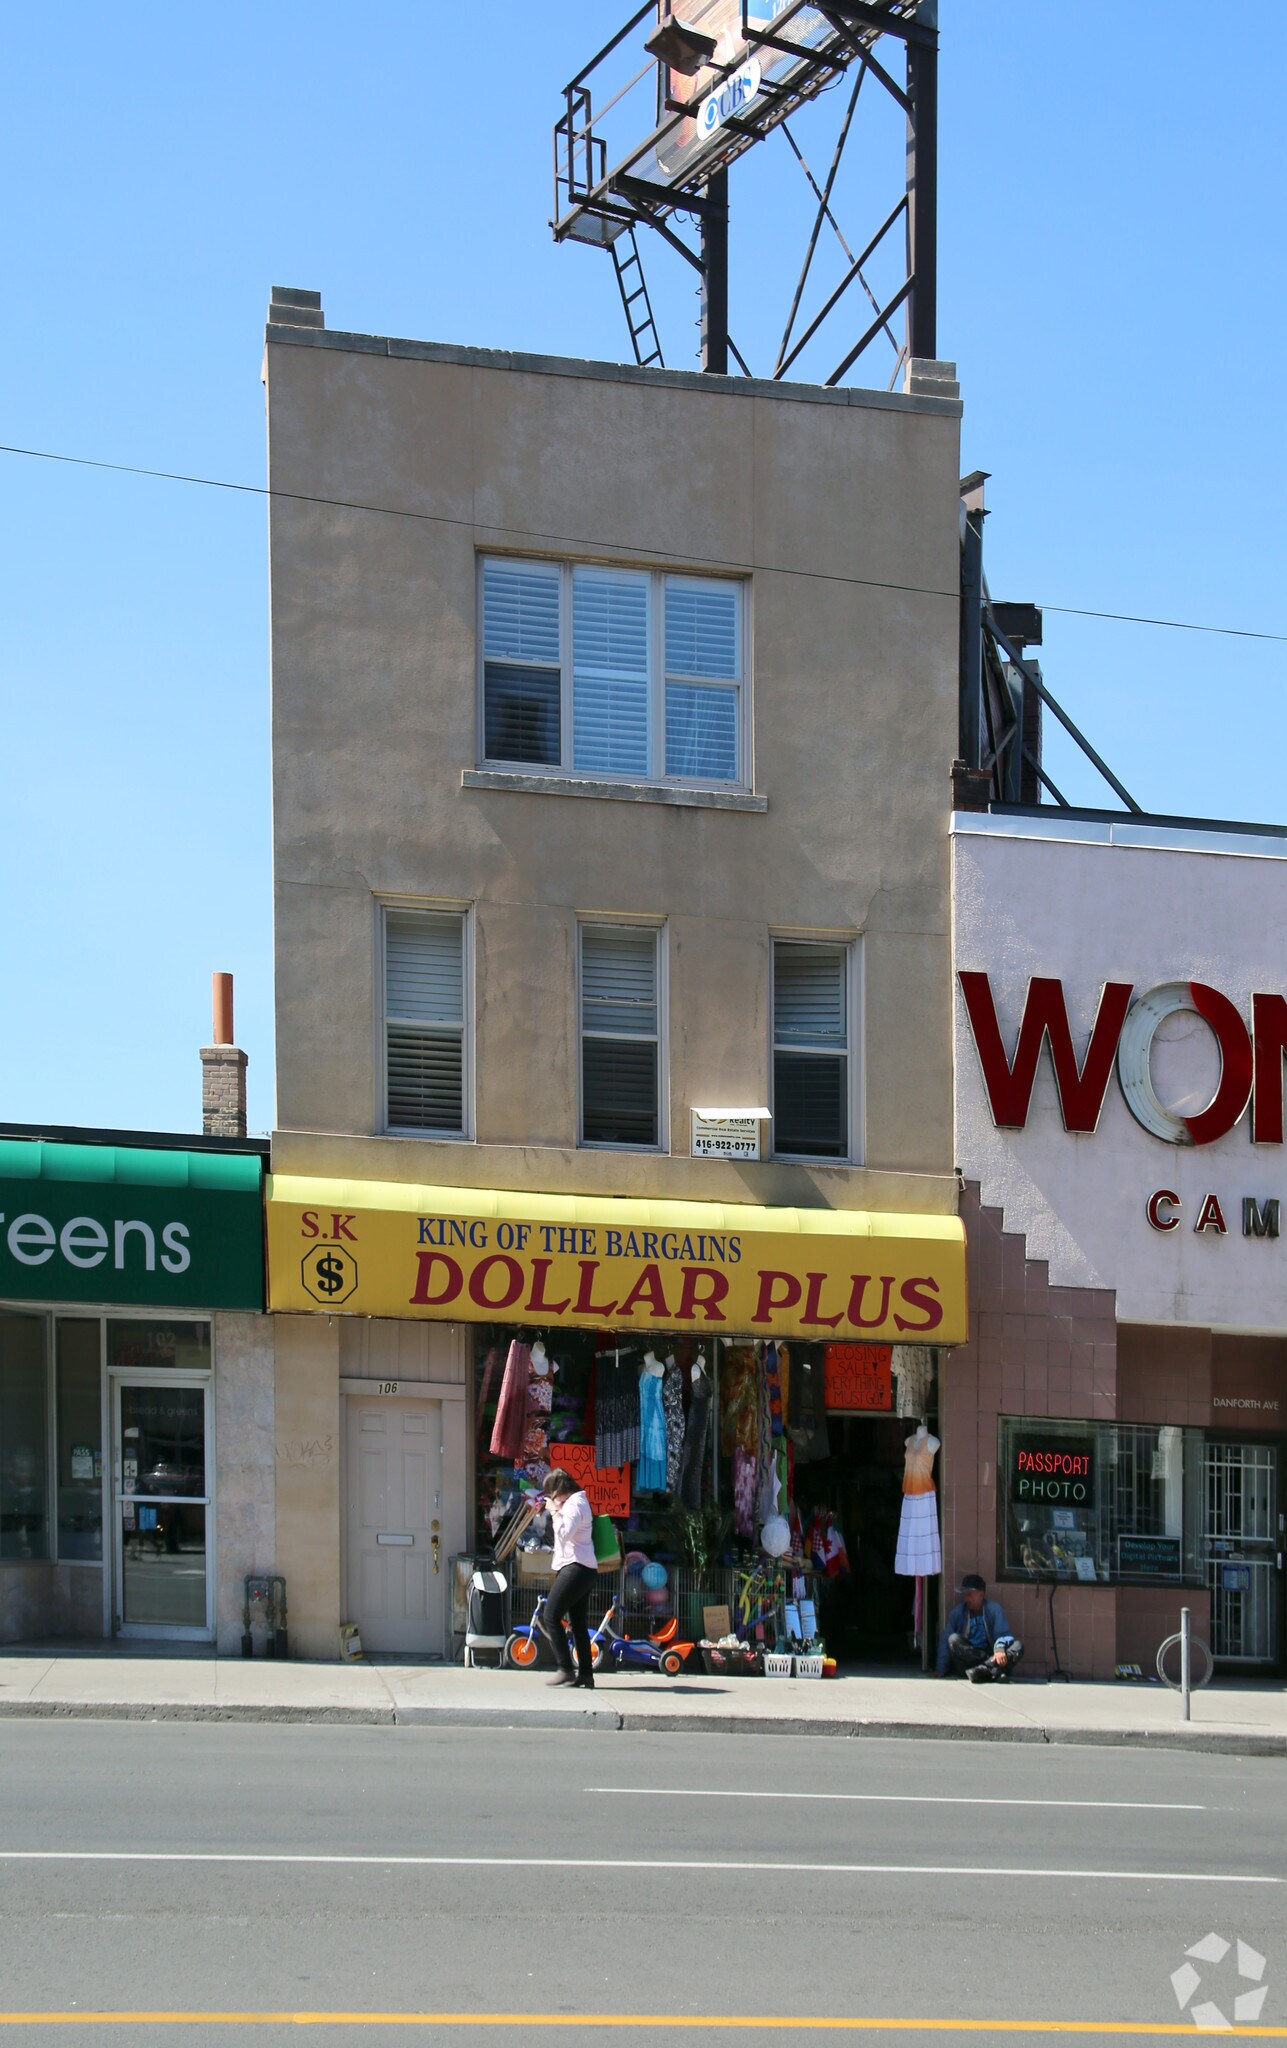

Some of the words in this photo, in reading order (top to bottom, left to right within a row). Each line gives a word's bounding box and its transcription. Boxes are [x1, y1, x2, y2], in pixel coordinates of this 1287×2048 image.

[720, 64, 752, 117] CBS
[1146, 1189, 1280, 1238] CAM
[301, 1211, 358, 1241] S.K
[417, 1217, 487, 1248] KING
[497, 1222, 531, 1250] OF
[540, 1226, 597, 1255] THE
[605, 1230, 741, 1263] BARGAINS
[408, 1251, 730, 1321] DOLLAR
[751, 1269, 944, 1332] PLUS
[824, 1345, 886, 1361] CLOSING
[836, 1361, 878, 1376] SALE!
[378, 1382, 398, 1394] 106
[834, 1391, 865, 1405] MUST
[1213, 1397, 1261, 1409] DANFORTH
[1263, 1401, 1280, 1411] AVE
[73, 1448, 90, 1457] PASS
[551, 1445, 597, 1462] CLOSI
[1018, 1451, 1089, 1475] PASSPORT
[573, 1462, 625, 1483] SALE!
[1019, 1479, 1086, 1500] PHOTO
[1124, 1540, 1156, 1550] Develop
[1158, 1542, 1175, 1550] Your
[1120, 1551, 1146, 1561] Digital
[1147, 1552, 1178, 1562] Pictures
